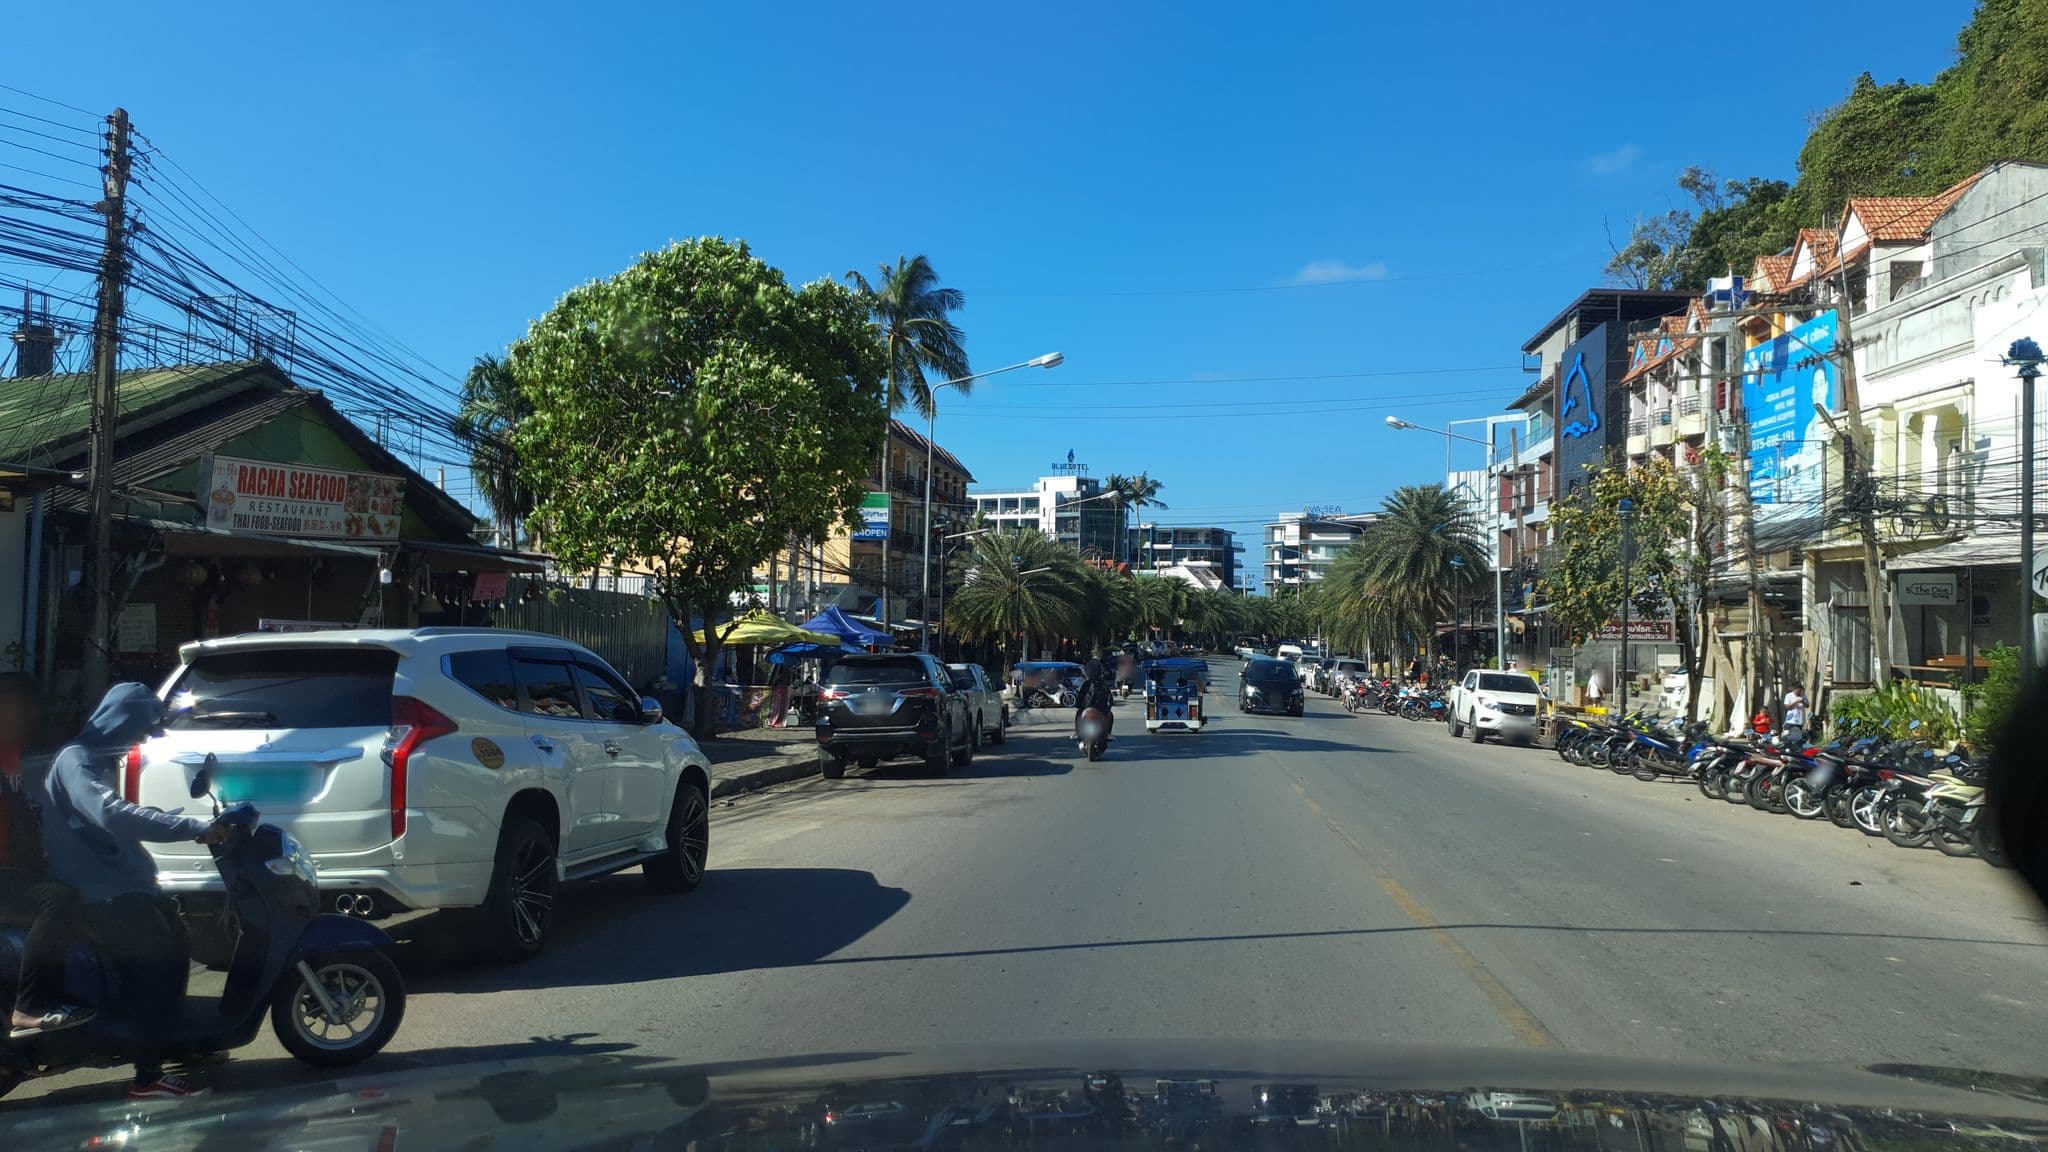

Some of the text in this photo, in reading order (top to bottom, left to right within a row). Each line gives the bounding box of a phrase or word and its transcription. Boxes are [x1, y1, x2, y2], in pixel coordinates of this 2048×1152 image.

[237, 465, 347, 503] RACHA SEAFOOD
[249, 501, 330, 517] RESTAURANT
[233, 513, 302, 532] THAI FOOD-SEAFOOD
[1626, 632, 1669, 641] onsultation
